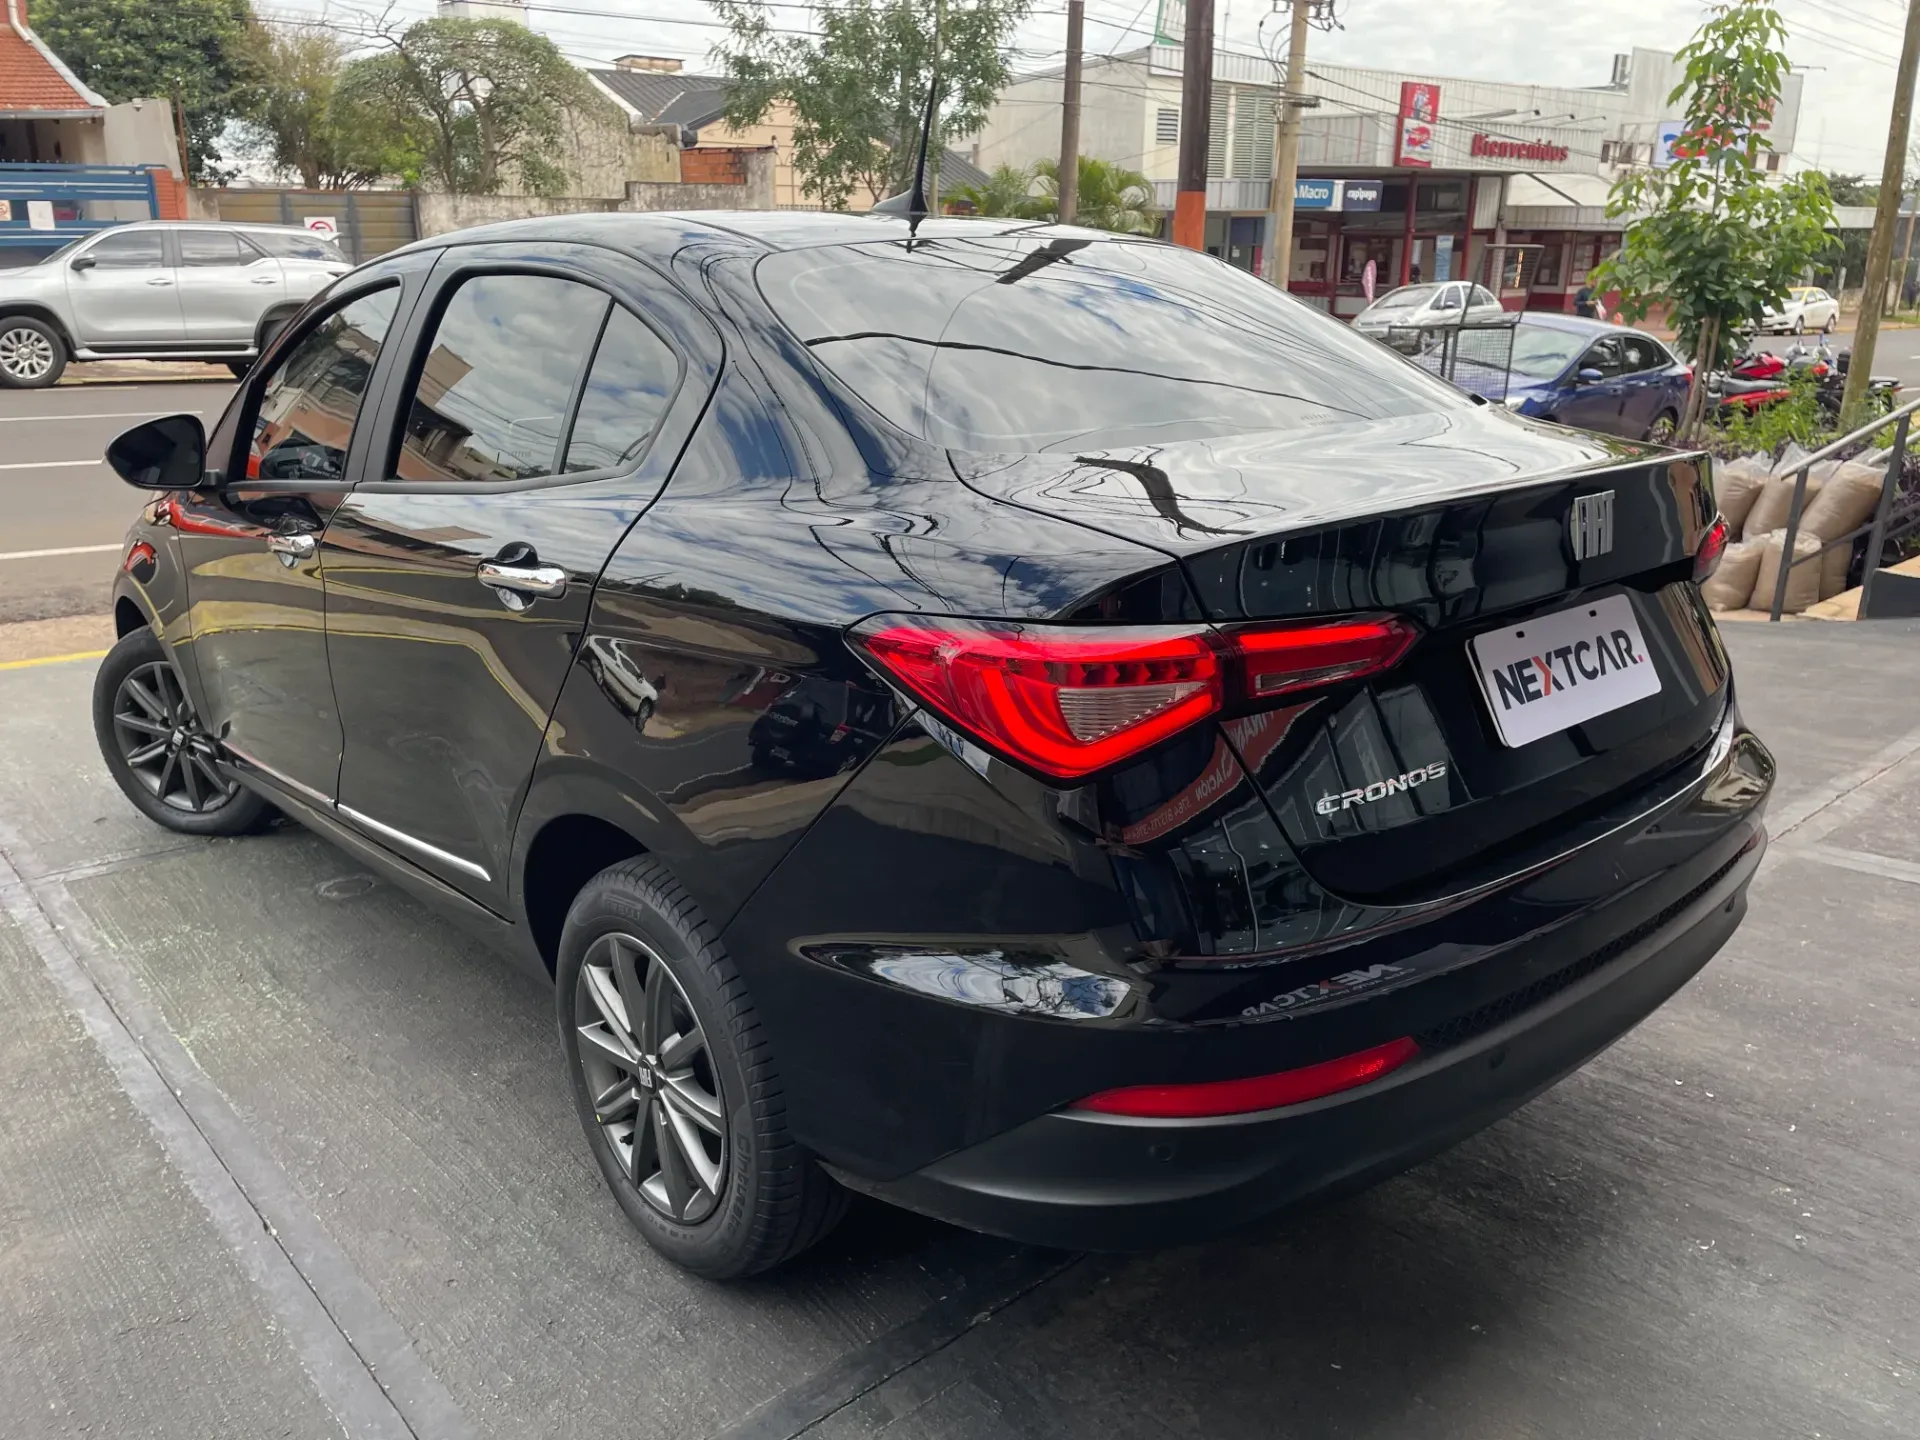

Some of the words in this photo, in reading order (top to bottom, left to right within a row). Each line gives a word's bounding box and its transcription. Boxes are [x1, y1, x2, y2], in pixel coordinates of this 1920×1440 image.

[1470, 132, 1569, 162] Bienvenidos
[1299, 184, 1329, 200] Macro
[1316, 760, 1447, 816] CRONOS
